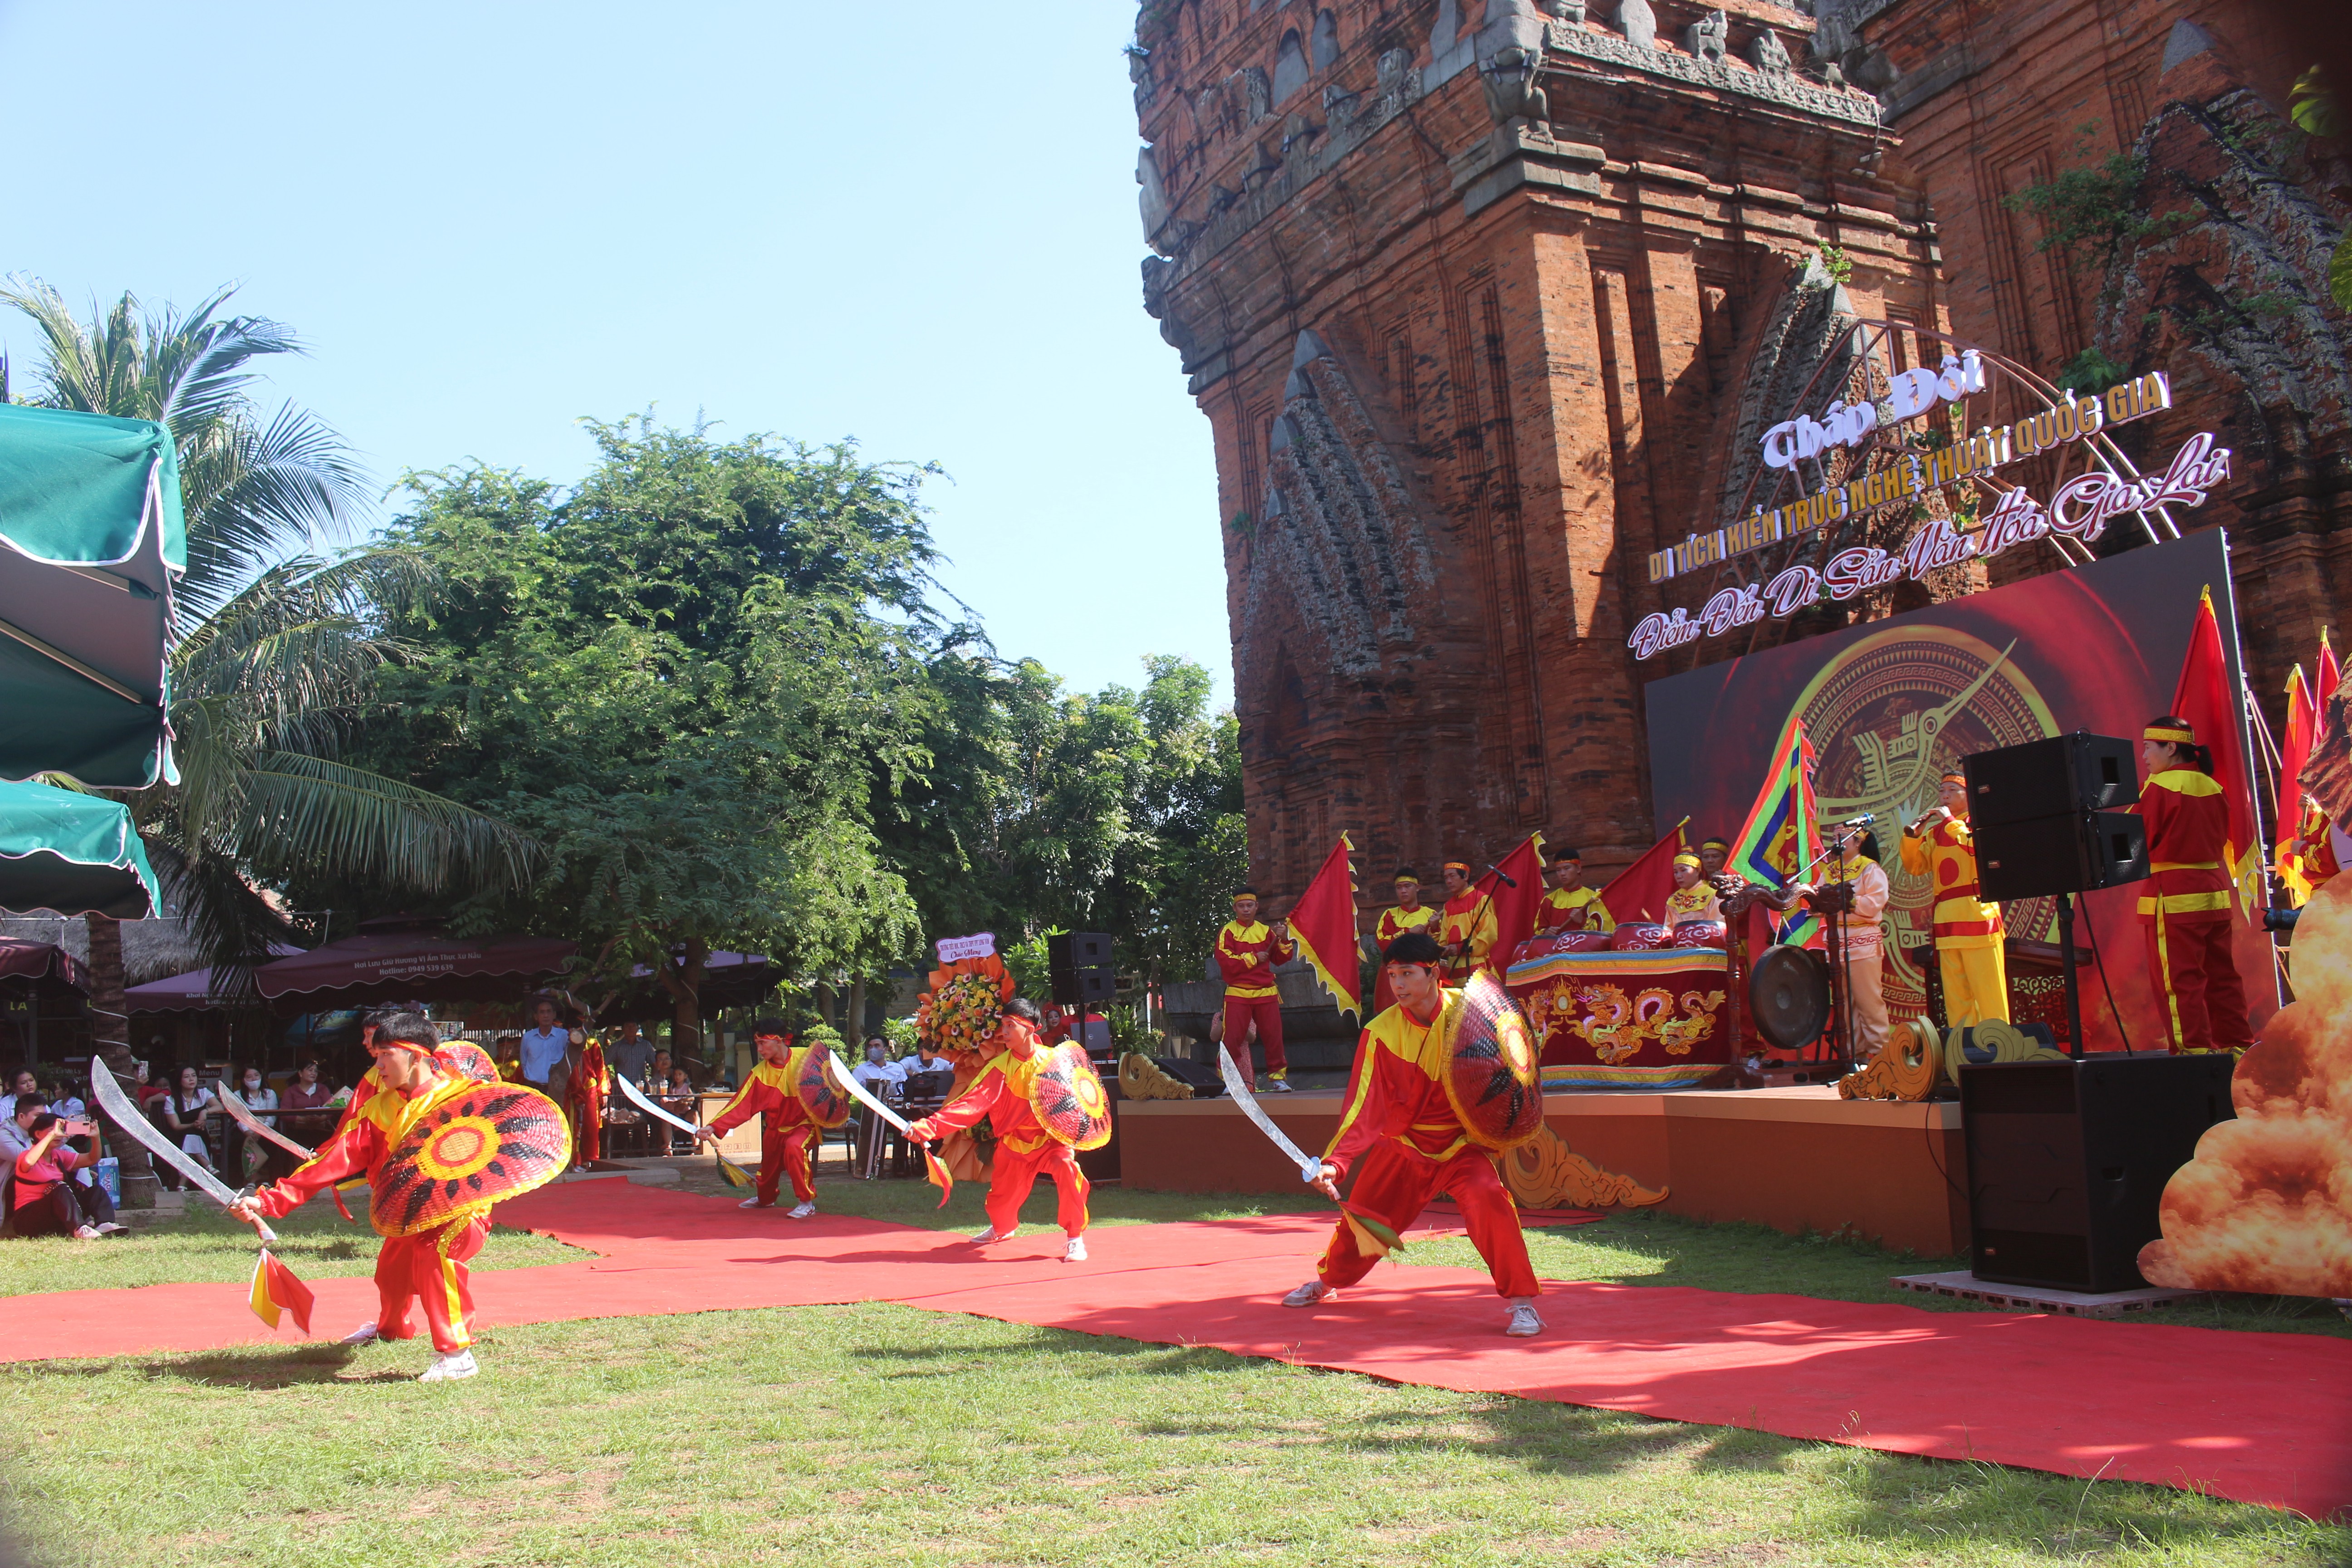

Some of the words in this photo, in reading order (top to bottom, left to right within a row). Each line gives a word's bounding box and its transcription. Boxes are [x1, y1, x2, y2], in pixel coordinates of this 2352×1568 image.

[1649, 548, 1673, 583] DI
[1675, 529, 1726, 573] TÍCH
[1727, 505, 1782, 555] KIẾN
[1782, 486, 1846, 535] TRÚC
[1849, 455, 1921, 513] NGHỆ
[1921, 426, 2011, 487] THUẬT
[2015, 388, 2103, 456] QUỐC
[2107, 372, 2171, 421] GIA
[1759, 400, 1876, 471] Tháp
[1886, 349, 1986, 423] Đôi
[1628, 608, 1700, 661] Điểm
[1699, 583, 1764, 637] Đến
[1763, 565, 1822, 617] Di
[1824, 547, 1901, 600] Sản
[1903, 520, 1975, 581] Văn
[1978, 486, 2048, 555] Hóa
[2048, 472, 2143, 541] Gia
[2141, 432, 2231, 511] Lai
[951, 951, 963, 959] Chúc
